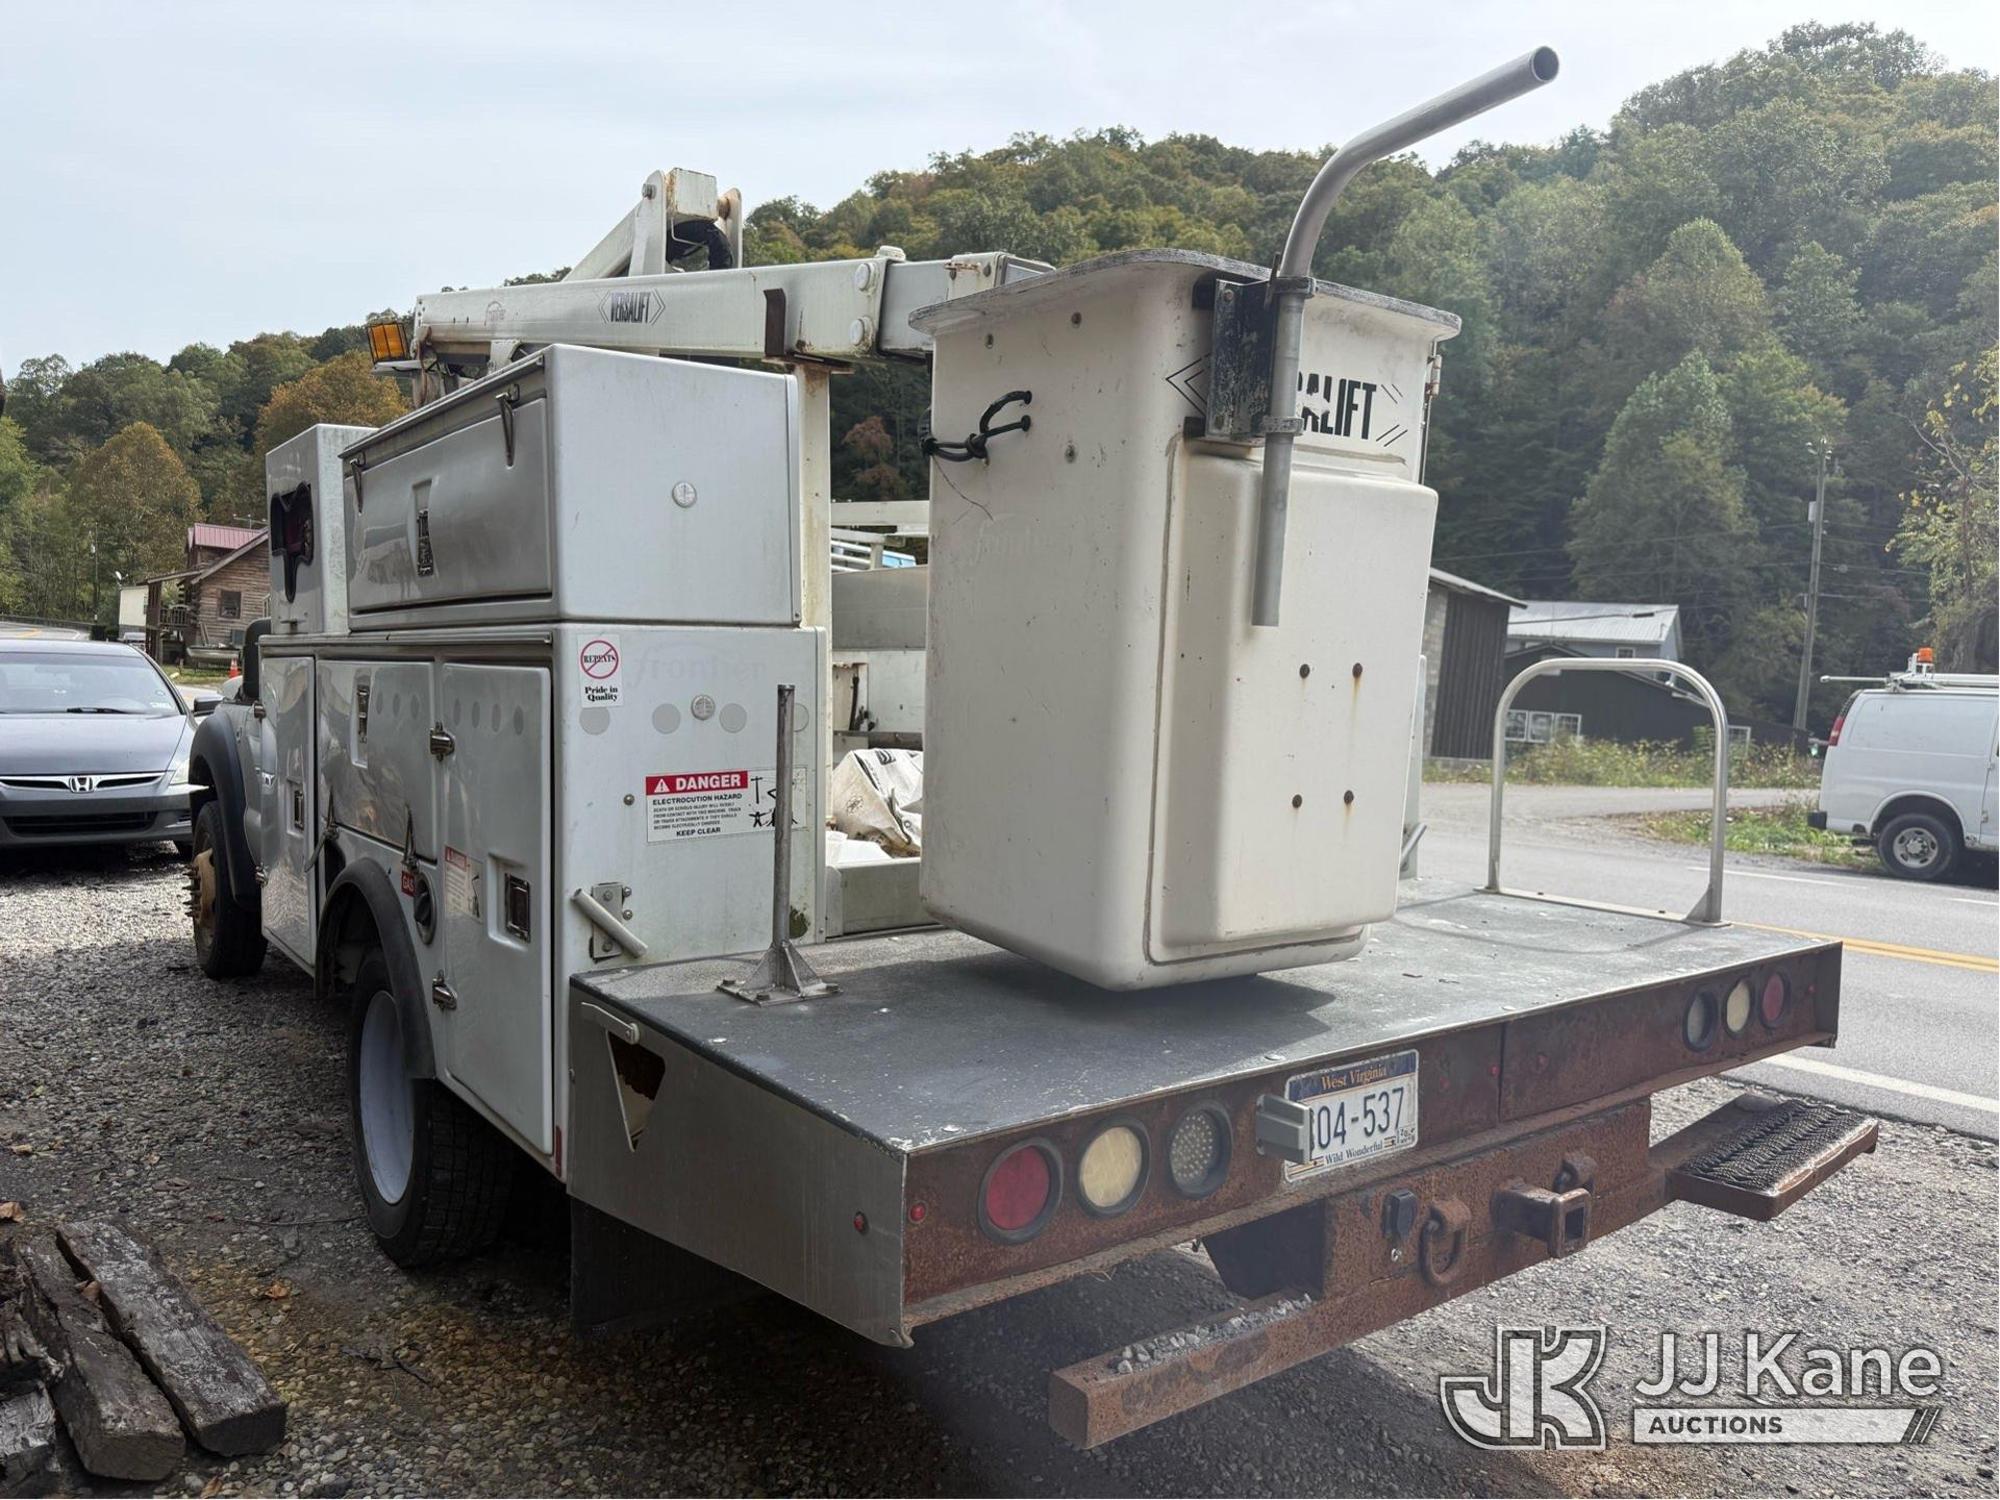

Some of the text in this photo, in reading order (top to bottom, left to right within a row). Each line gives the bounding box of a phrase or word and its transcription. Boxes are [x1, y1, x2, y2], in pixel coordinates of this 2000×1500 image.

[1297, 370, 1377, 440] ALIFT
[585, 685, 618, 694] Pride in
[587, 693, 617, 702] Quality
[675, 773, 742, 791] DANGER
[653, 793, 742, 805] ELECTROCUTION HAZARD
[697, 827, 721, 835] CLEAR
[1322, 1065, 1387, 1089] West Virginia
[1310, 1086, 1404, 1149] 04-537
[1325, 1141, 1383, 1164] Wild Wonderful
